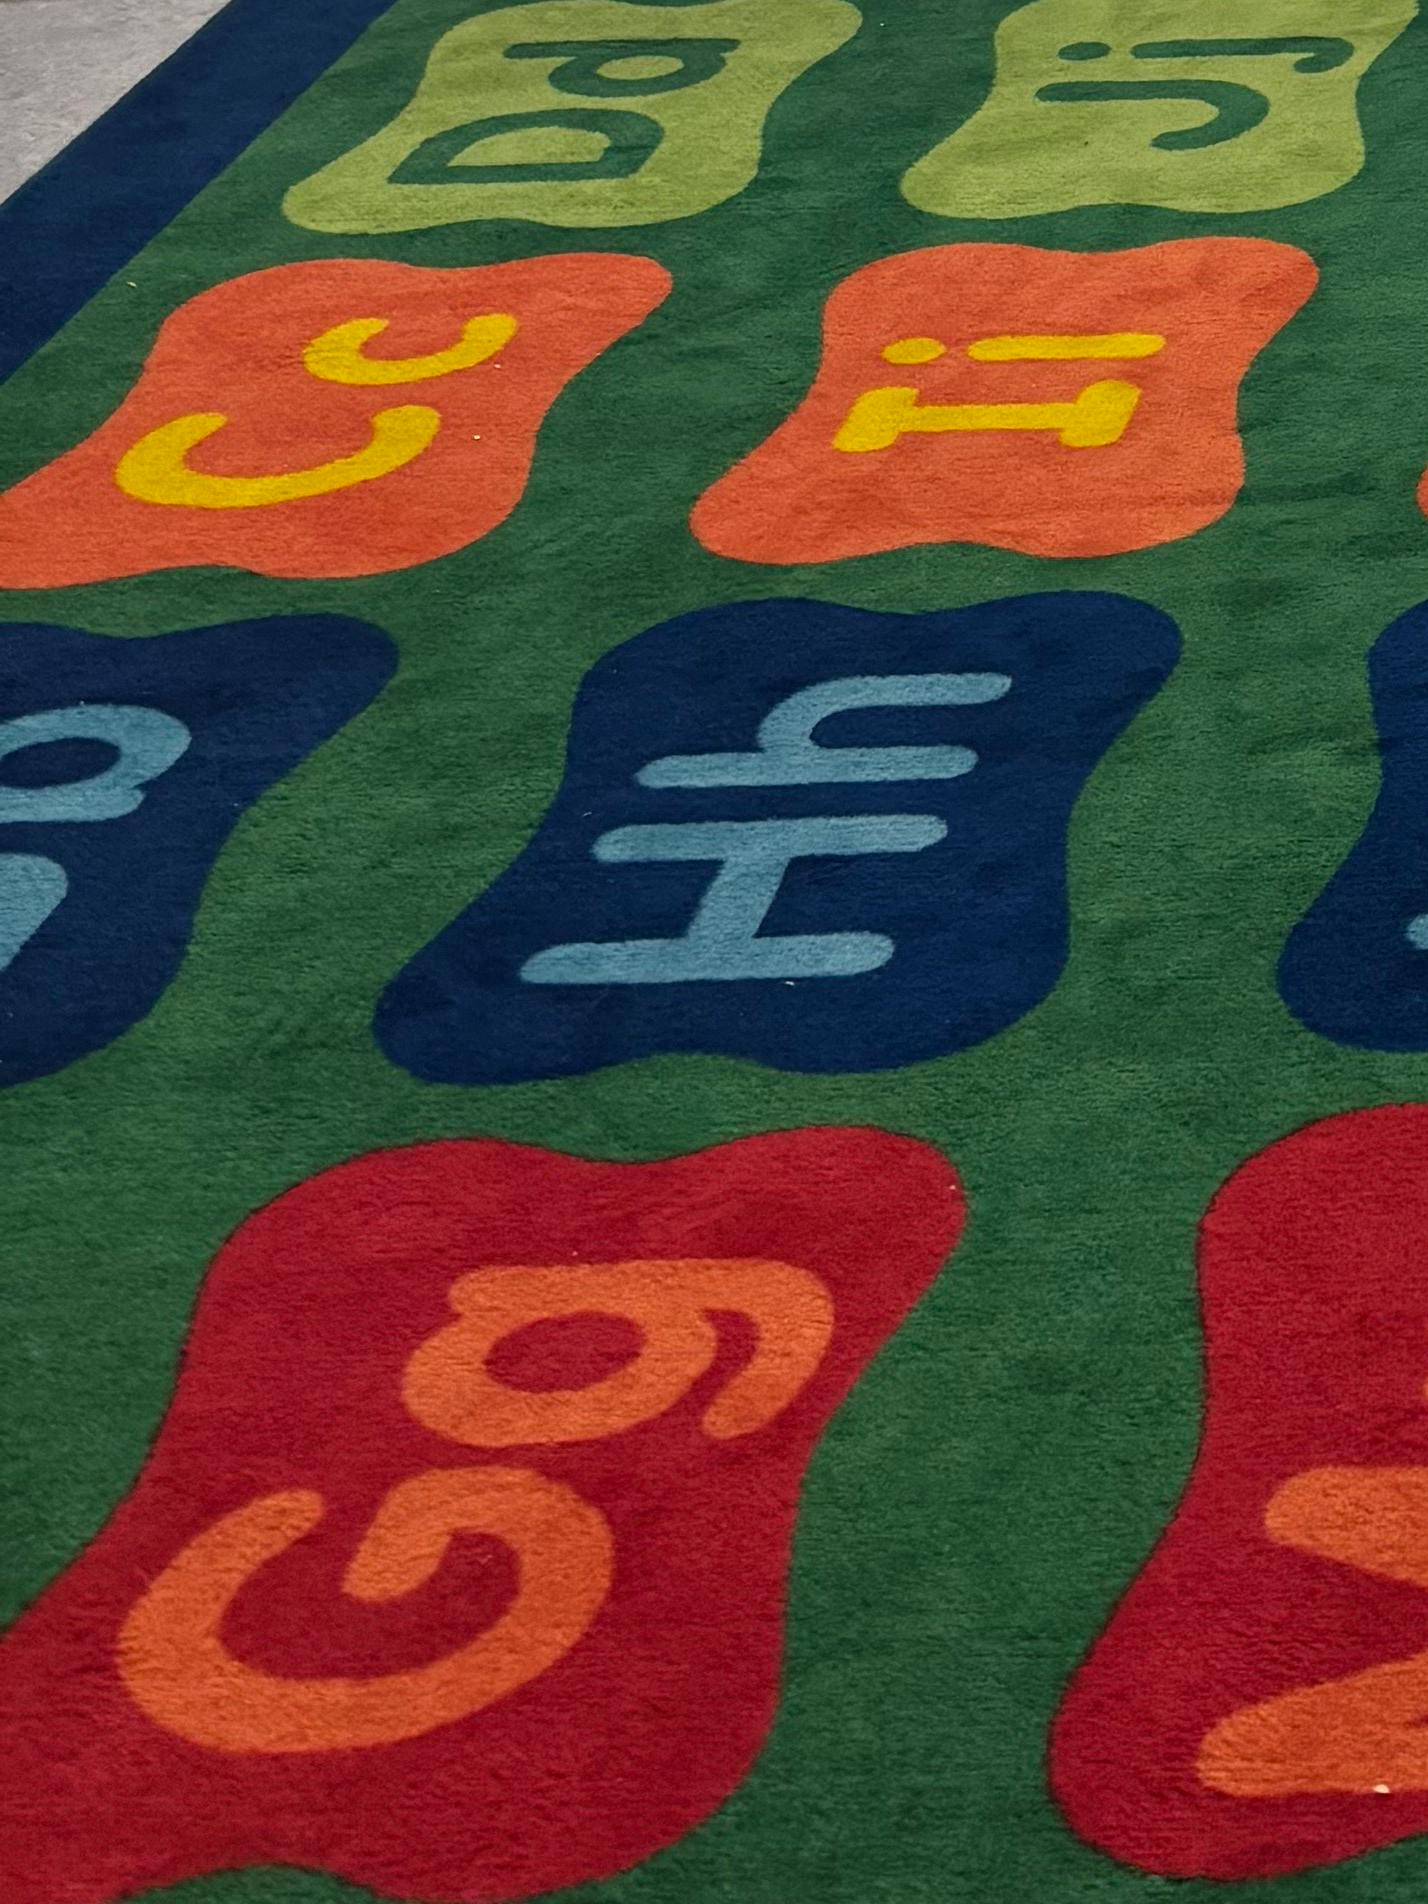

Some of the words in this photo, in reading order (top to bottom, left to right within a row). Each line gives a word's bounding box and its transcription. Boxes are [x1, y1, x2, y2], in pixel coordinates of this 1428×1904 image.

[402, 35, 740, 187] Dd
[1037, 35, 1353, 151] Jj
[115, 313, 517, 507] Cc
[833, 334, 1165, 453] Ii
[518, 672, 1012, 985] Hh
[115, 1258, 834, 1754] Gg
